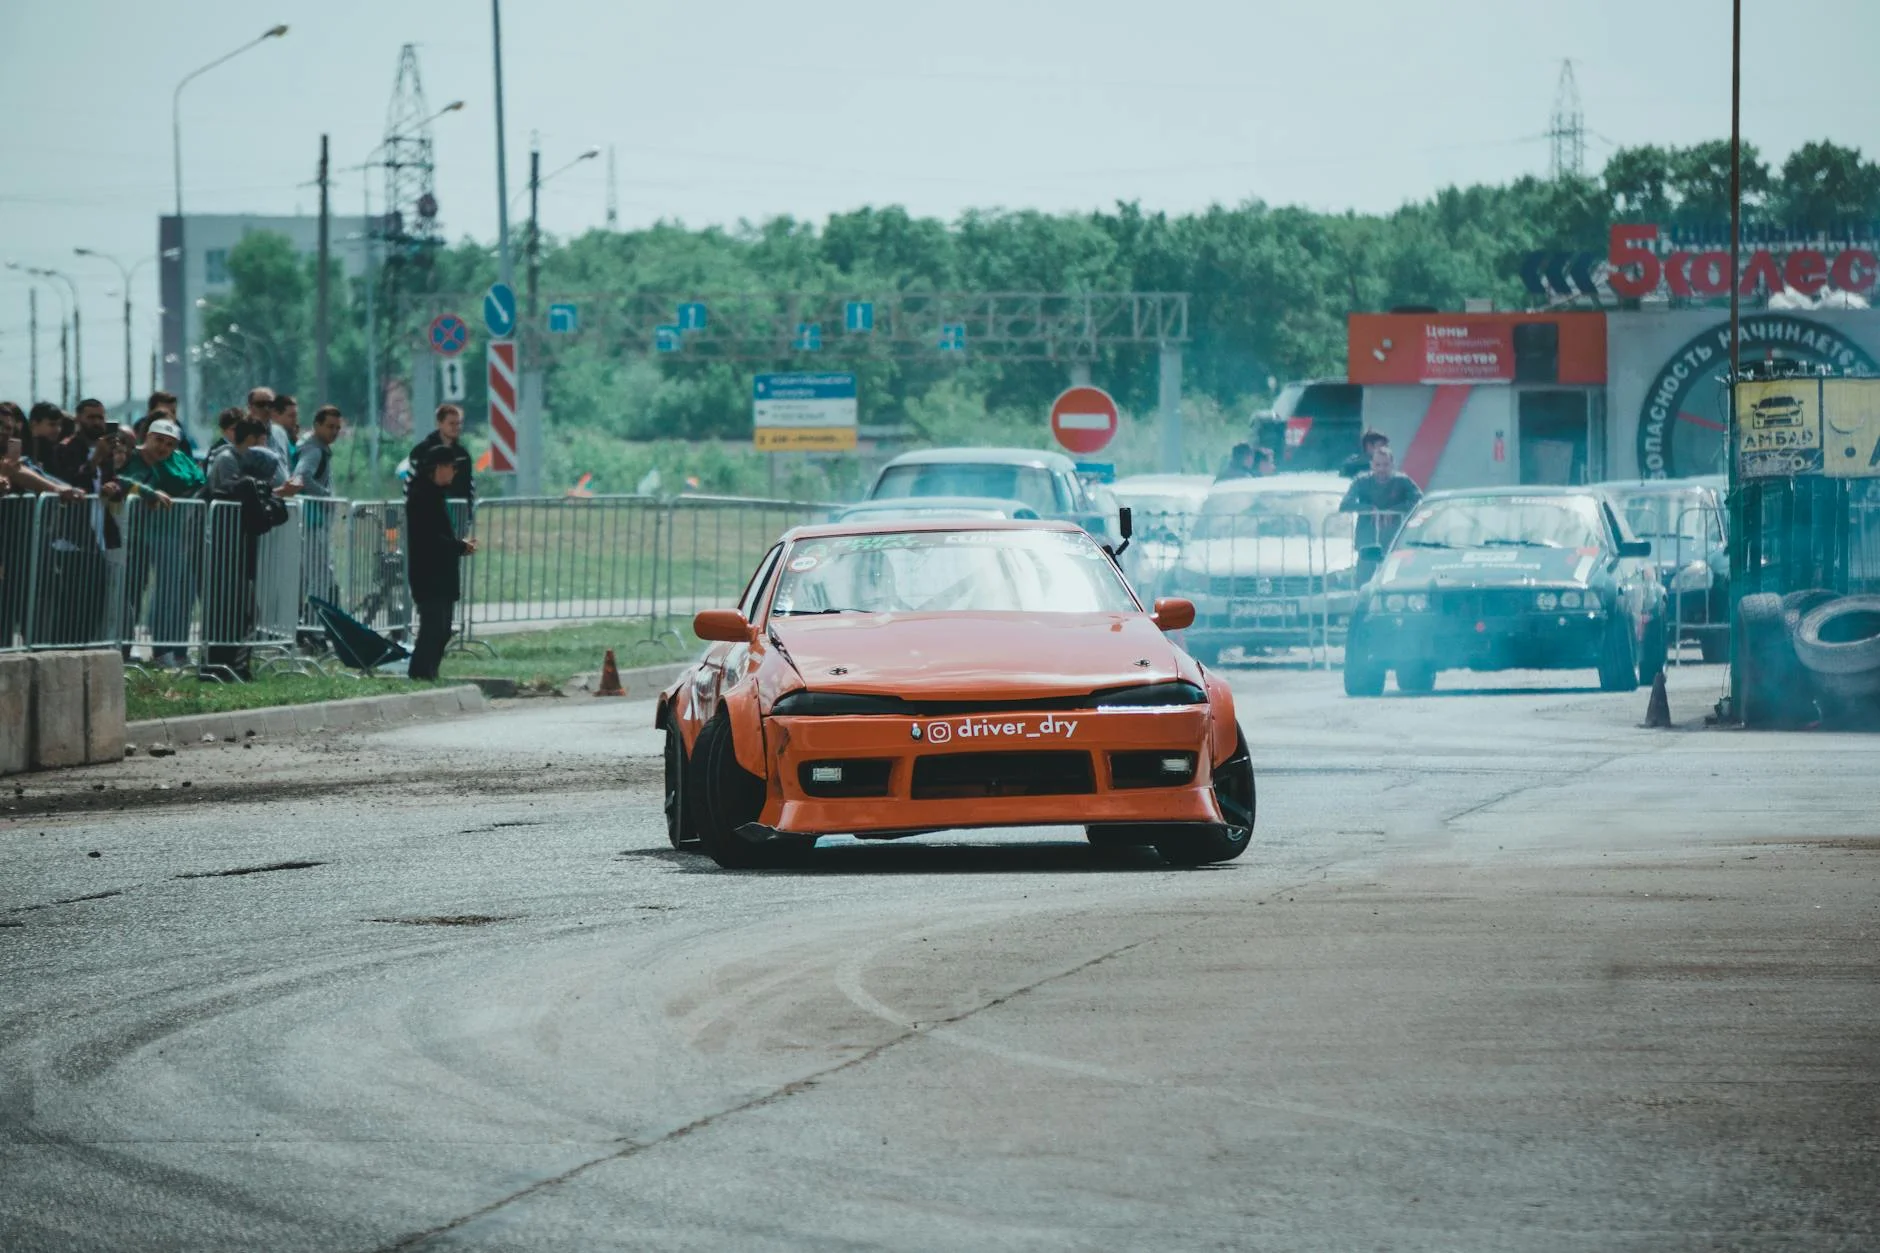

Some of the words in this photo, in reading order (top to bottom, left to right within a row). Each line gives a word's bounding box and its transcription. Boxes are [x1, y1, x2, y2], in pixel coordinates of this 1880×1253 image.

[1426, 324, 1468, 340] Цены
[1426, 352, 1497, 365] Качество
[957, 713, 1078, 738] driver_dry
